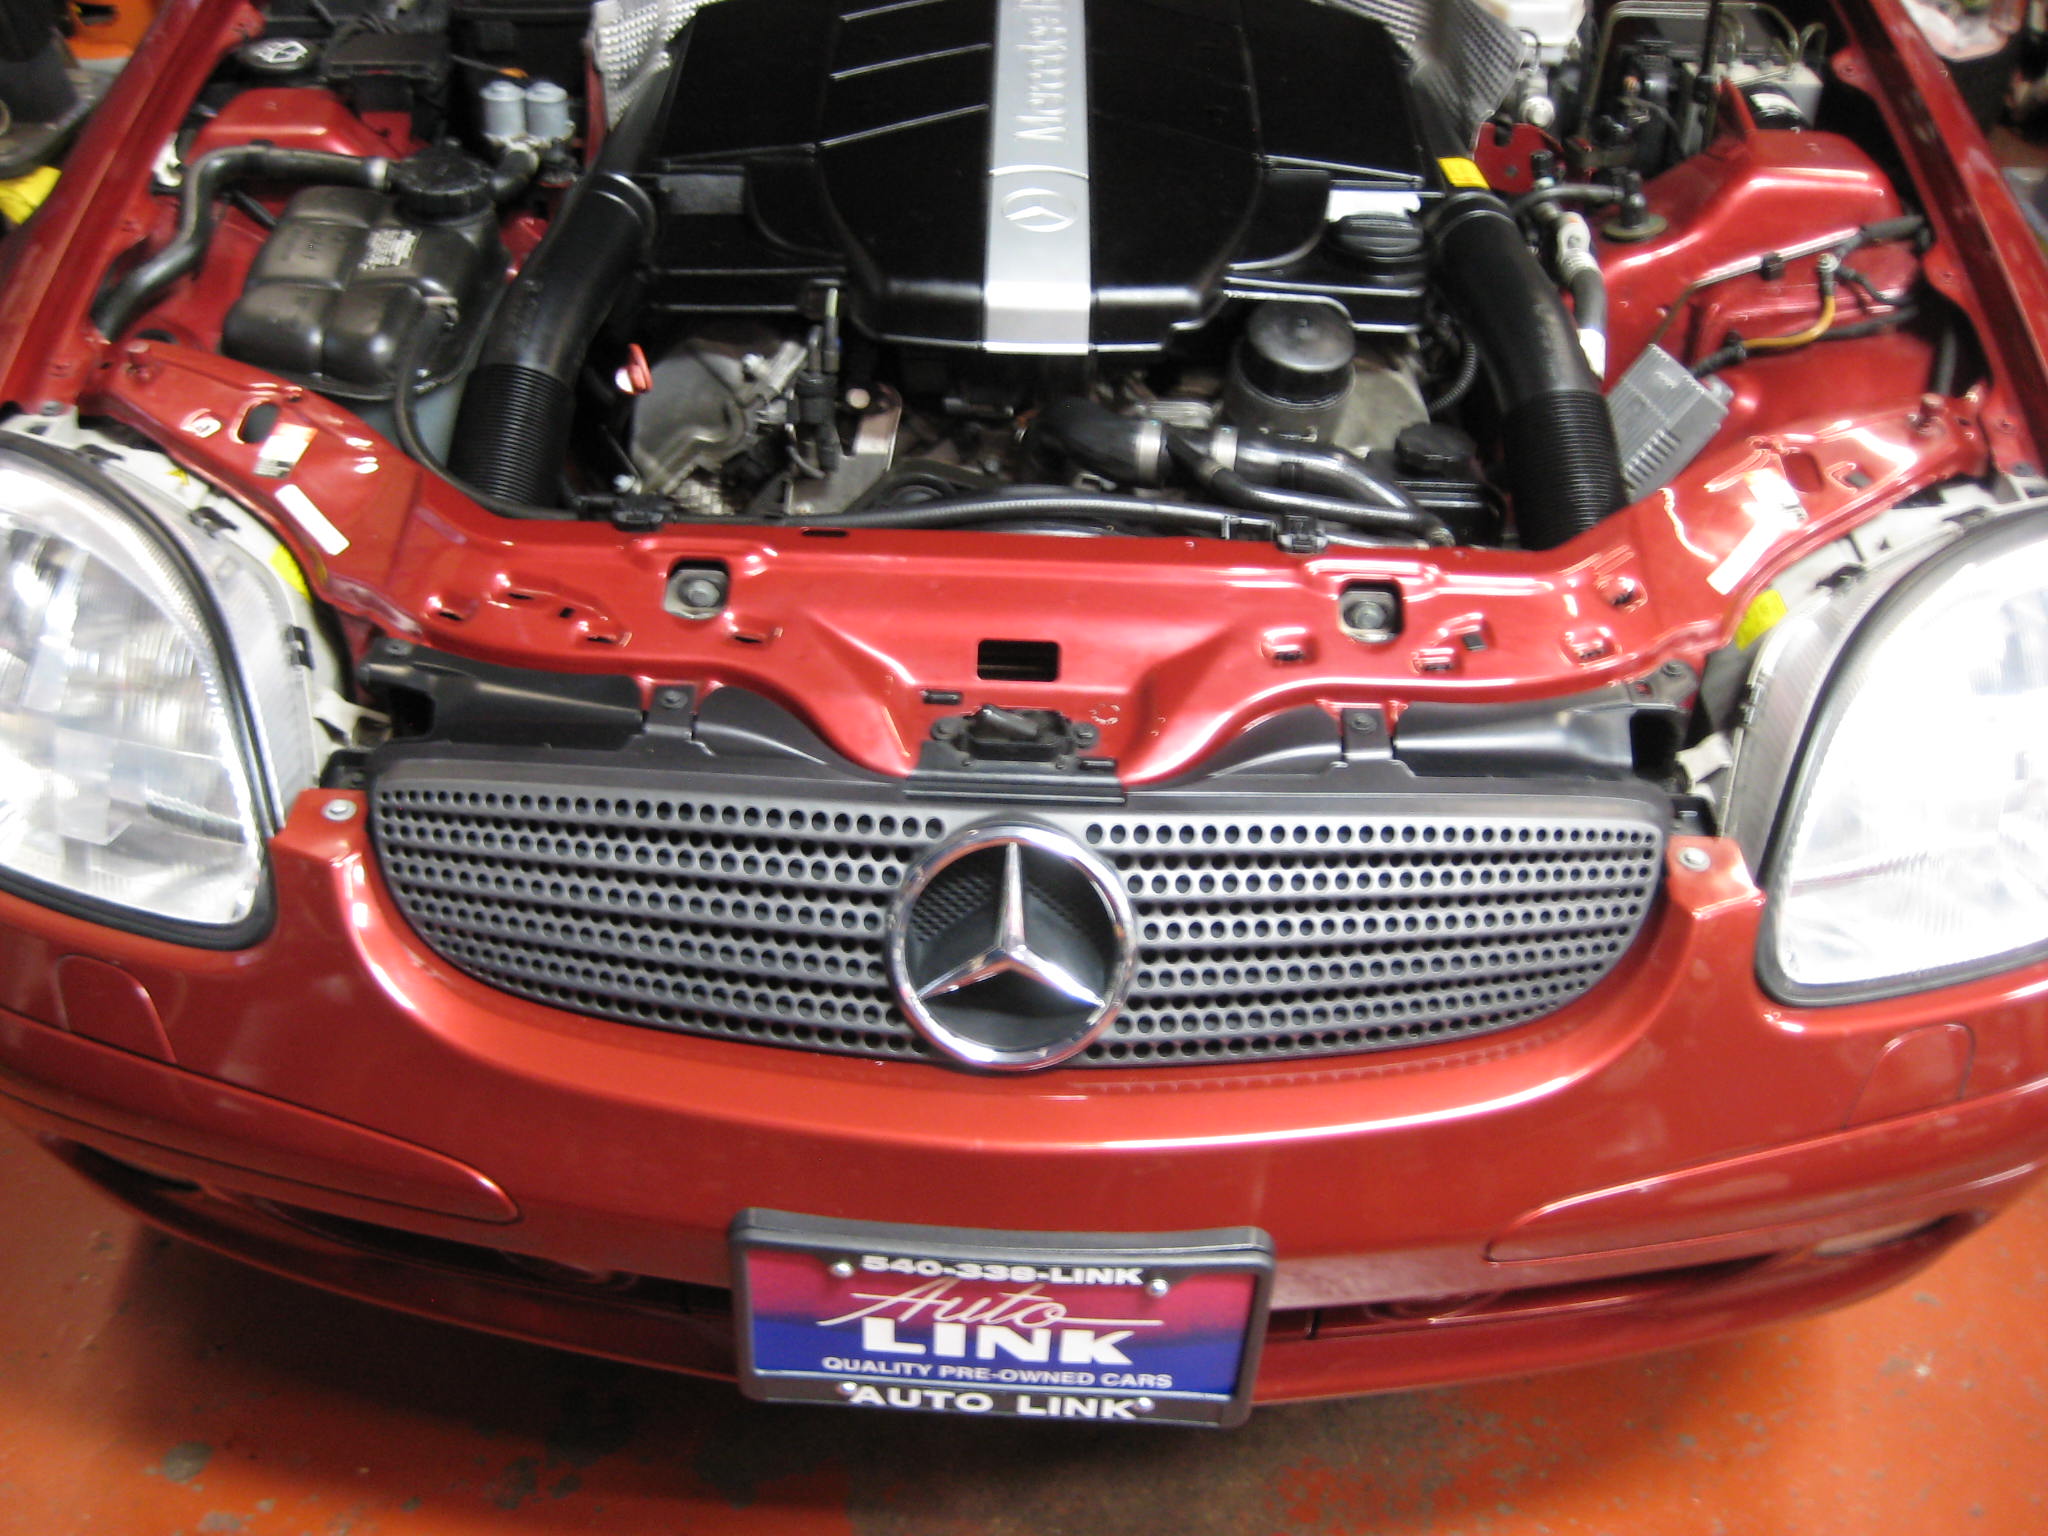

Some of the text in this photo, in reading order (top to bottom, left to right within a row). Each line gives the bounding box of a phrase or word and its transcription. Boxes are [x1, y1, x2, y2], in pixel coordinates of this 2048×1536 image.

[816, 1276, 1164, 1328] Auto
[862, 1316, 1133, 1366] LINK
[821, 1356, 1173, 1389] QUALITY PRE-OWNED CARS
[850, 1385, 1138, 1420] AUTO LINK
